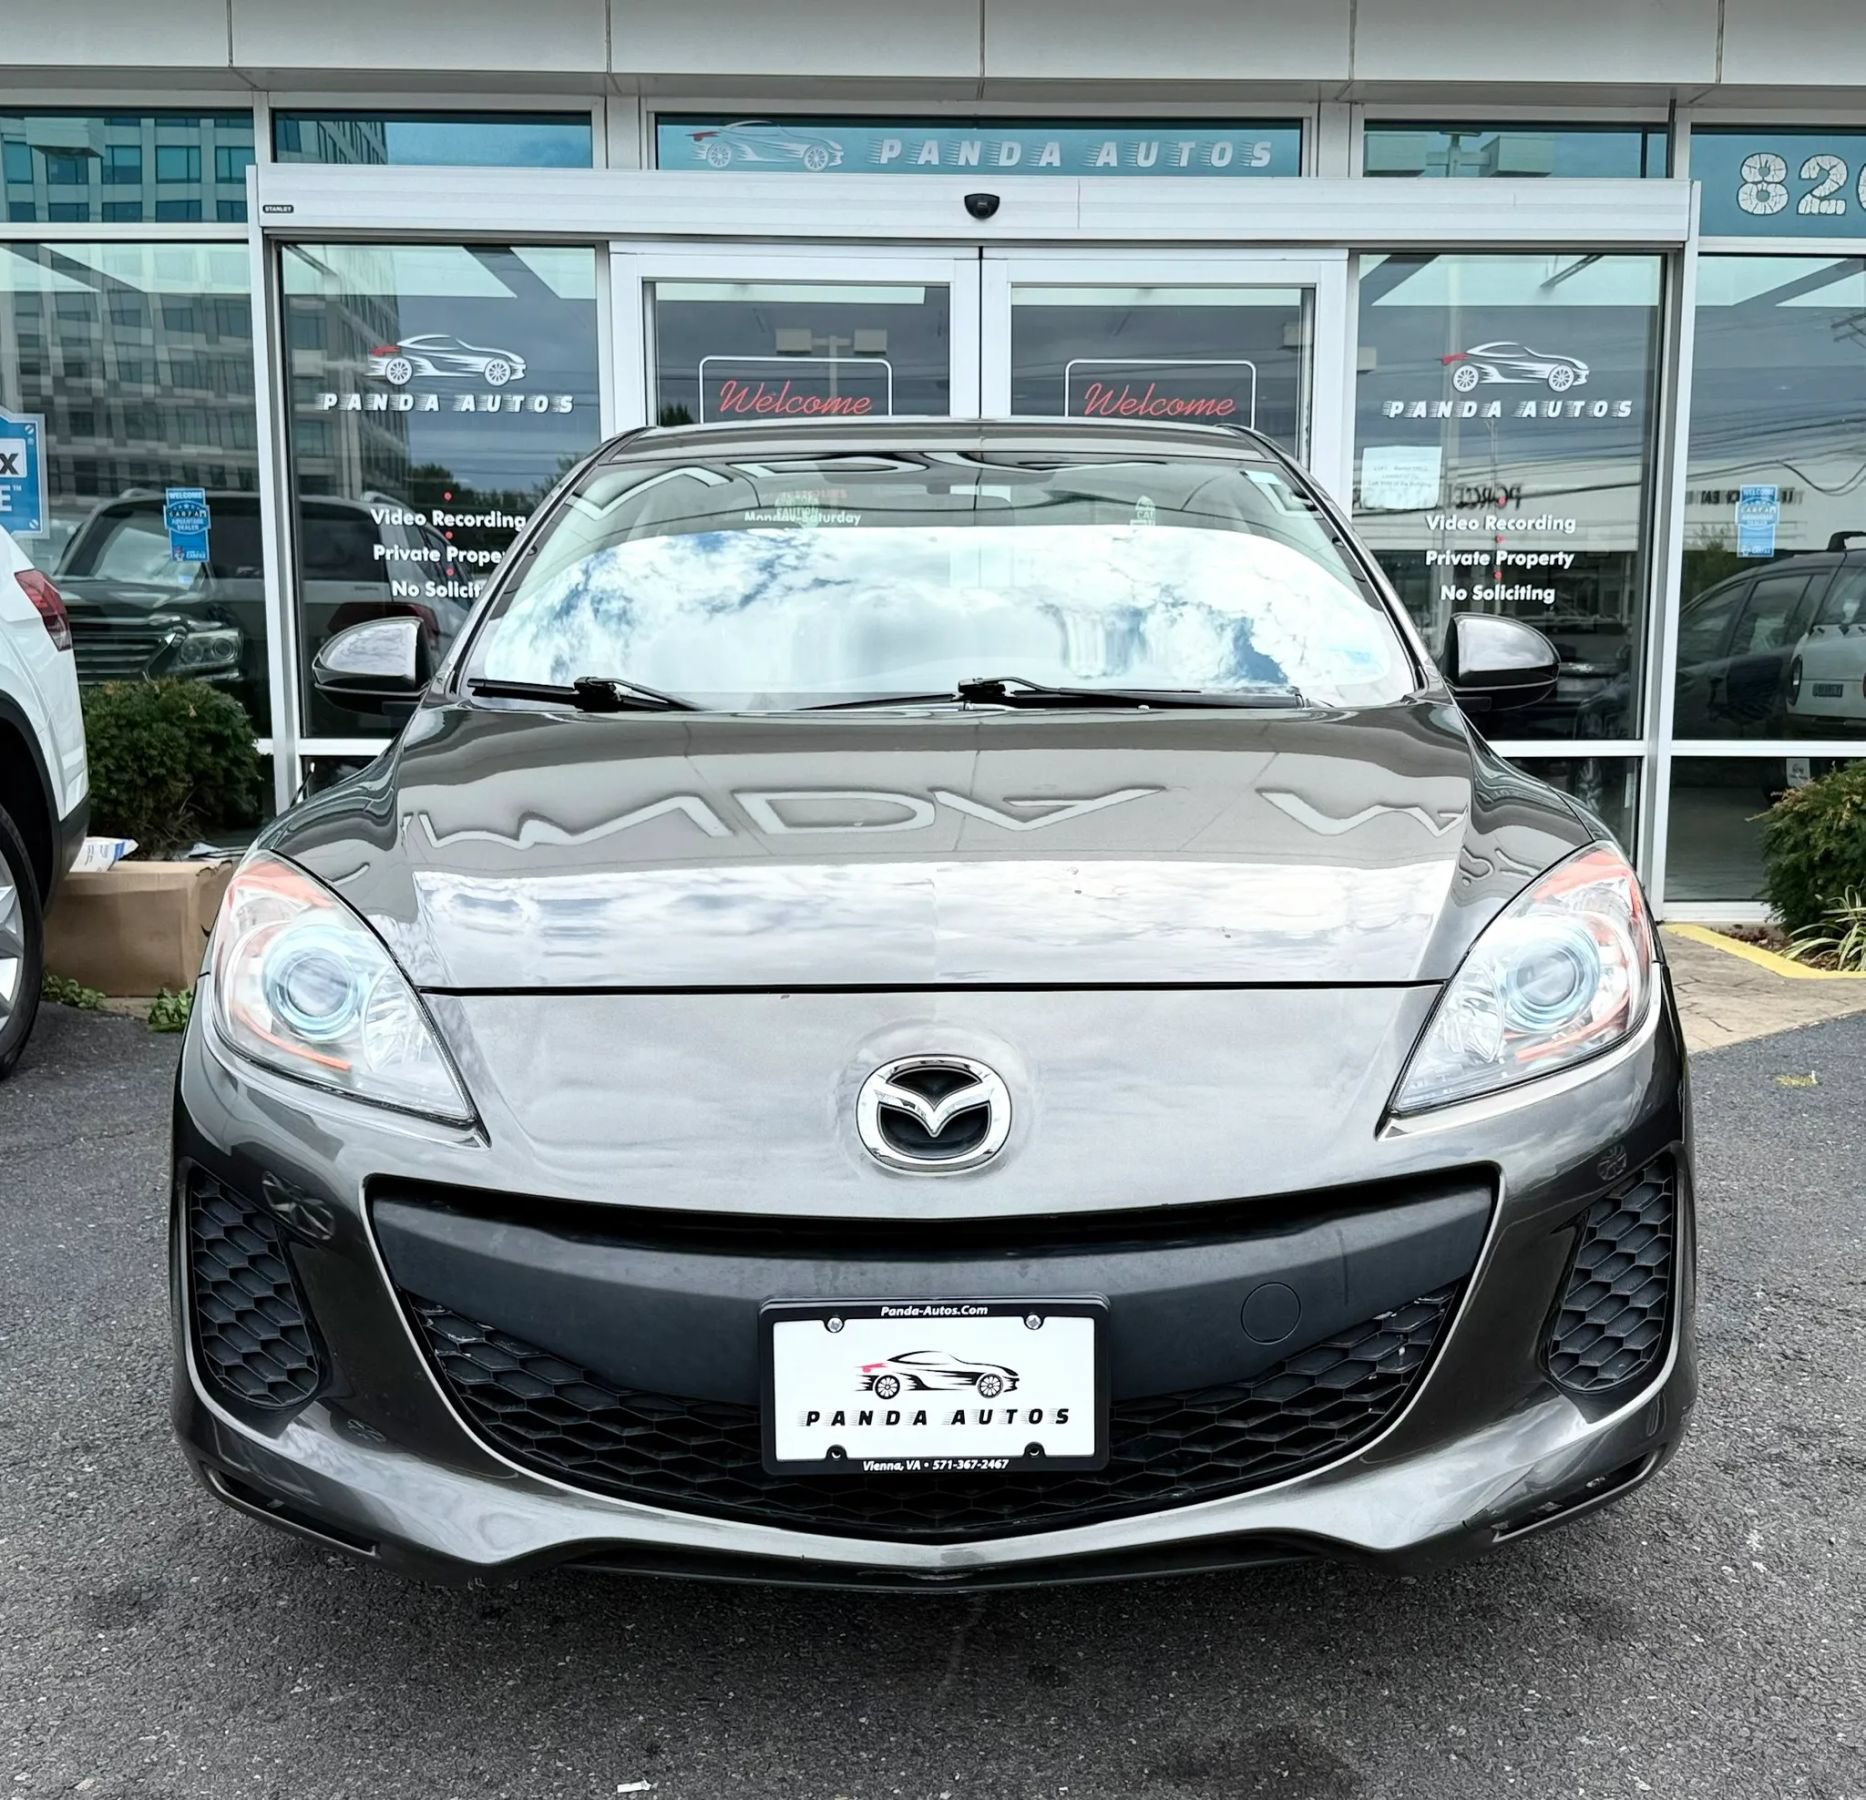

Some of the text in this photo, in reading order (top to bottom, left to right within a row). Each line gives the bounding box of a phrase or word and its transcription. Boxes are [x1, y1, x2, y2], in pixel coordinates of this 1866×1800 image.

[875, 138, 1272, 168] PANDA AUTOS
[1737, 152, 1866, 215] 82
[320, 393, 574, 414] PANDA AUTOS
[720, 380, 872, 414] Welcome
[1084, 383, 1236, 416] Welcome
[1386, 400, 1632, 418] PANDA AUTOS
[370, 509, 527, 531] Video Recording
[1426, 514, 1576, 533] Video Recording
[373, 544, 441, 561] Private
[1426, 550, 1574, 569] Private Property
[392, 580, 483, 598] No Solicit
[1440, 585, 1555, 604] No Soliciting
[880, 1305, 988, 1317] Panda-Autos.Com
[803, 1408, 1069, 1426] PANDA AUTOS
[863, 1459, 1009, 1471] Vienna, VA 571-367-2467
